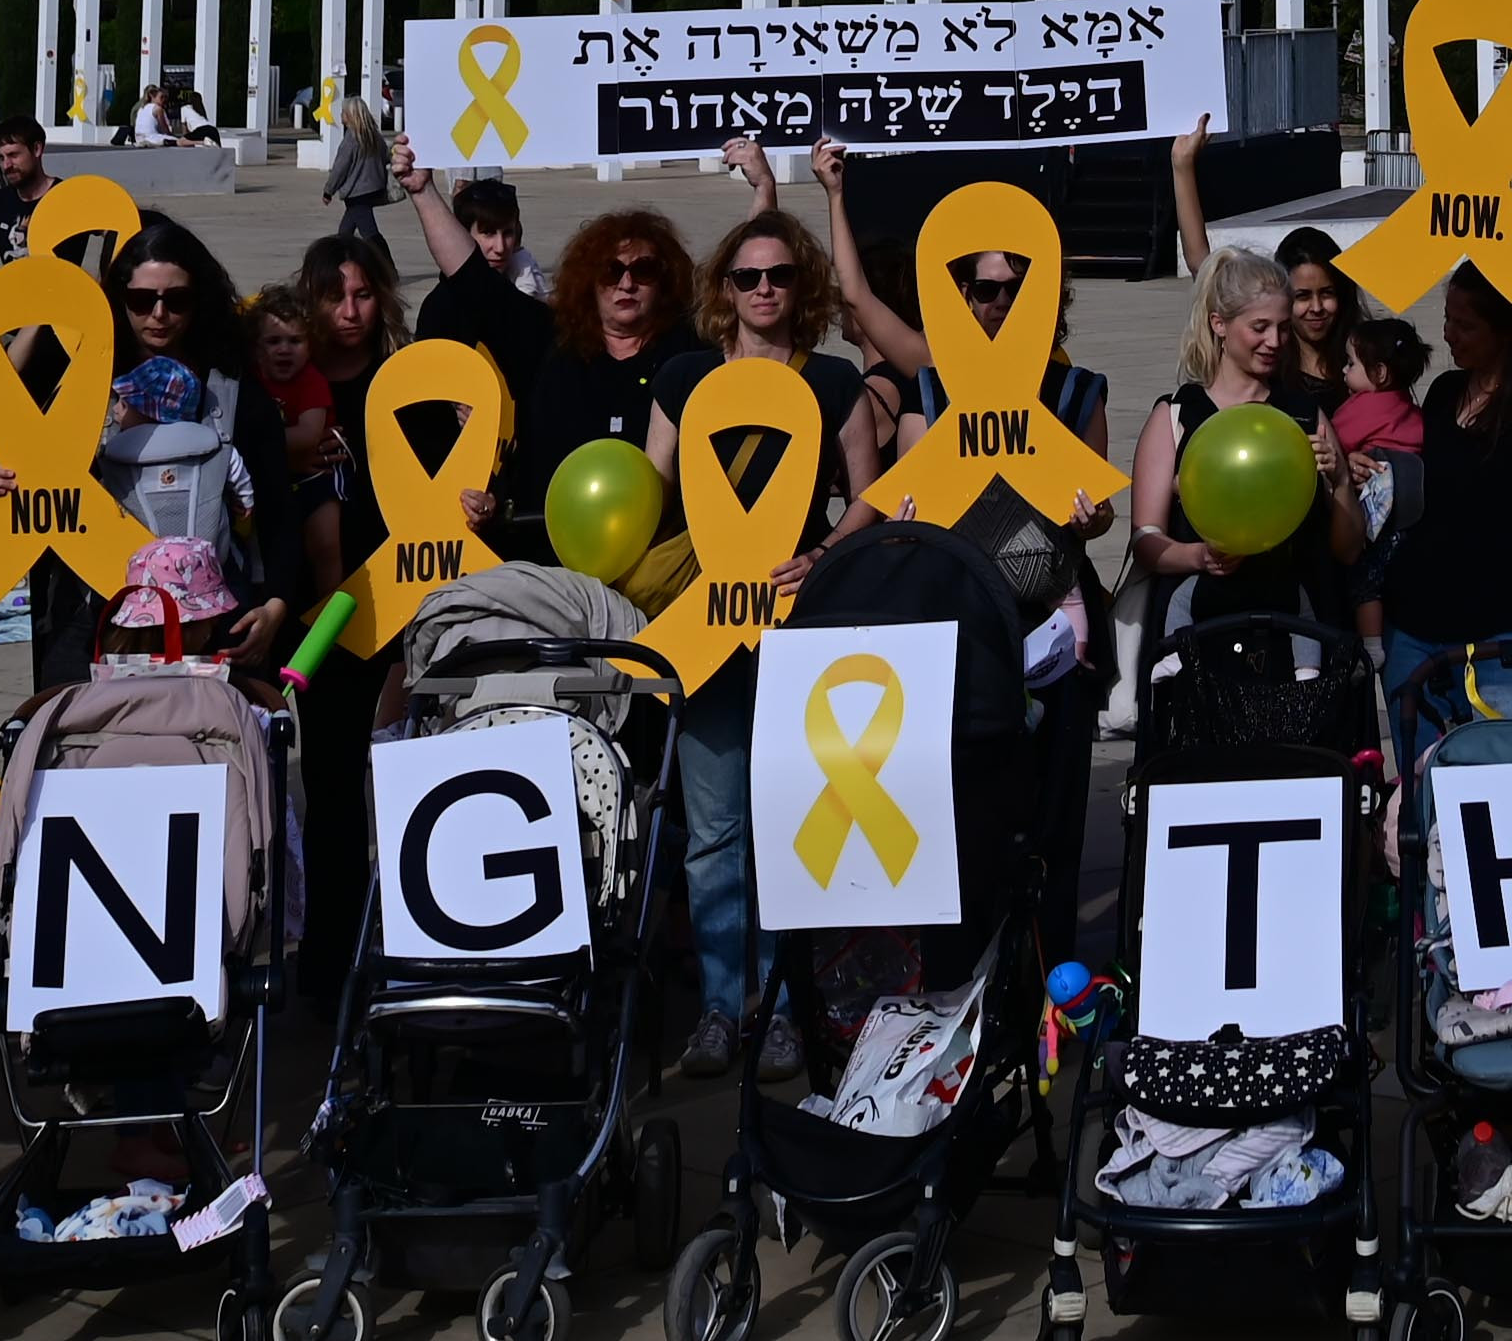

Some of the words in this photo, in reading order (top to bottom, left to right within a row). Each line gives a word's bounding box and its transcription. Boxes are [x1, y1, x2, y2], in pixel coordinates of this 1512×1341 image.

[1431, 194, 1504, 241] NOW.
[960, 410, 1035, 457] NOW.
[11, 485, 87, 534] NOW.
[397, 541, 468, 582] NOW.
[707, 582, 782, 627] NOW.
